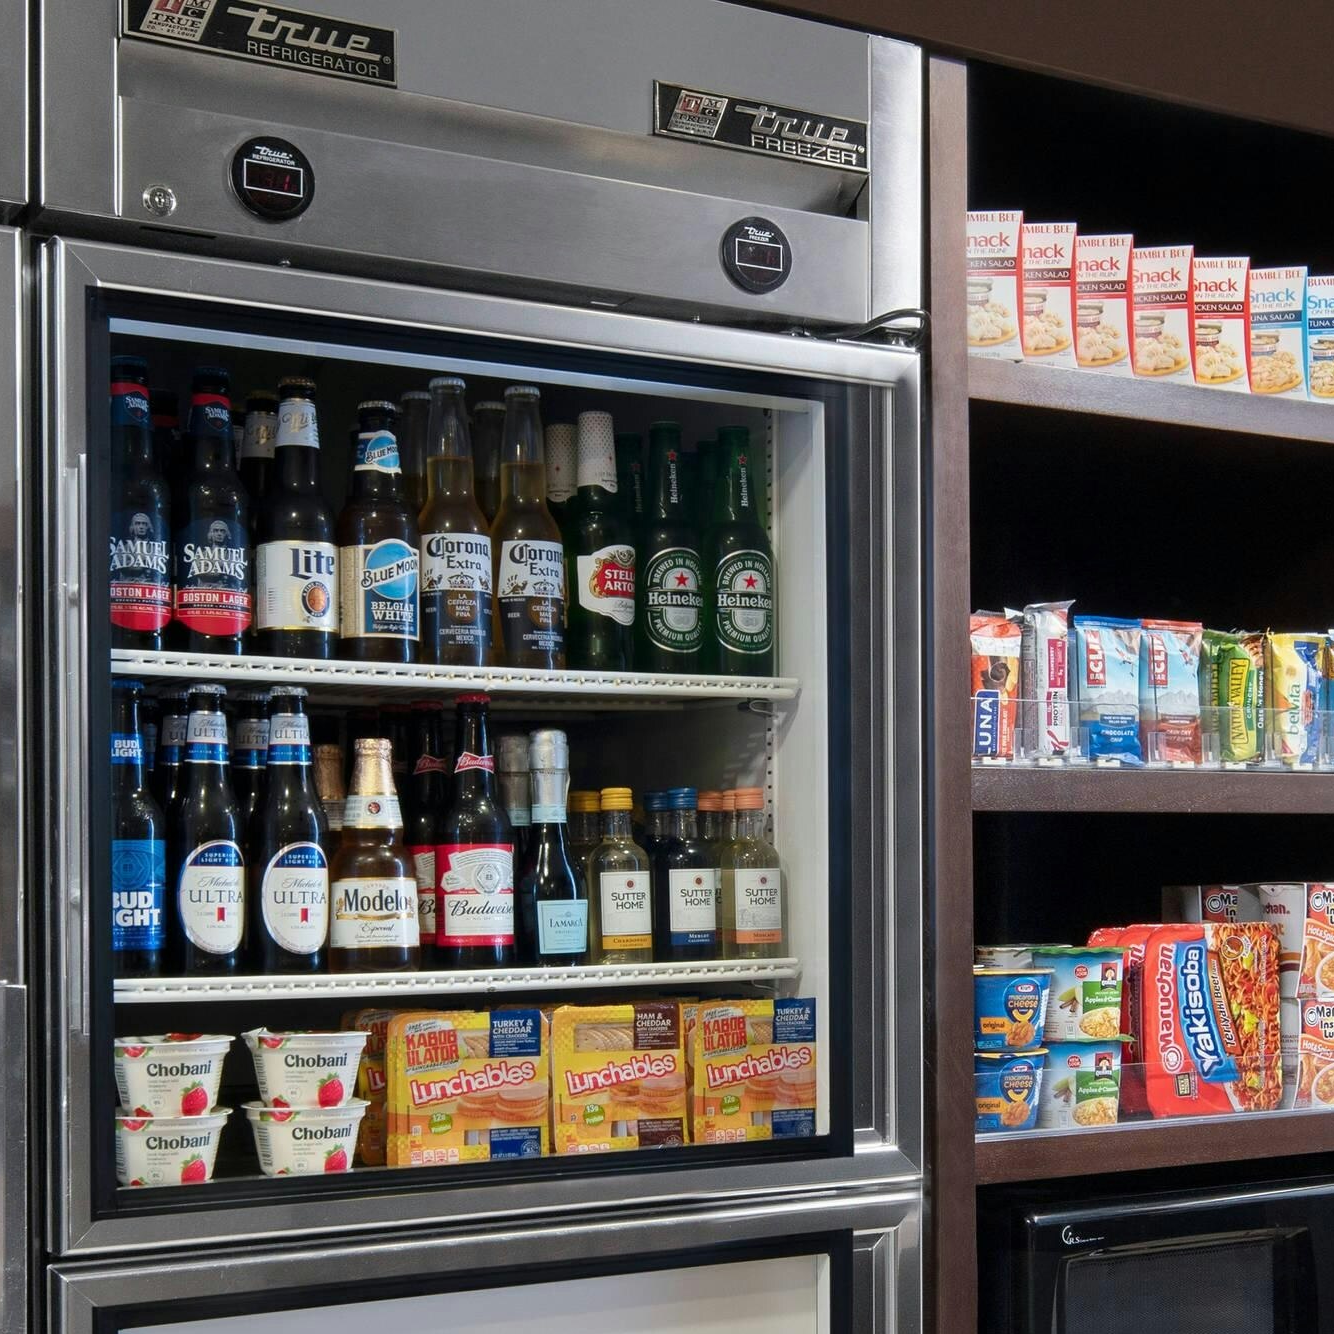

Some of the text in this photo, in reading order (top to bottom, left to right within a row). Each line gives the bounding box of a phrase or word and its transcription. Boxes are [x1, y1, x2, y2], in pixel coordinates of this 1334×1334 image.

[152, 12, 202, 28] TRUE
[248, 41, 379, 77] REFRIGERATOR
[751, 135, 857, 165] FREEZER
[988, 259, 1015, 267] SALAD
[740, 467, 748, 507] Heineken
[183, 543, 248, 566] SAMUEL
[289, 547, 335, 580] Lite
[187, 559, 244, 580] ADAMS
[371, 601, 414, 612] BELGIAN
[1089, 631, 1102, 672] CLIF
[1153, 634, 1164, 674] CLIF
[1230, 661, 1246, 702] VALLEY
[114, 740, 138, 749] BUD
[343, 888, 408, 913] Modelo
[611, 892, 646, 901] SUTTER
[680, 888, 712, 898] SUTTER
[685, 898, 711, 906] HOME
[449, 894, 514, 915] Budweise
[616, 901, 644, 910] HOME
[1198, 947, 1217, 1068] Yakisoba
[493, 1019, 524, 1028] TURKEY
[637, 1019, 671, 1027] CHEDDAR
[703, 1018, 745, 1034] KABOB
[1218, 1000, 1236, 1048] Teriyaki
[405, 1029, 457, 1050] KABOB
[704, 1031, 747, 1051] ULATOR
[284, 1053, 347, 1068] Chobani
[406, 1045, 460, 1067] ULATOR
[147, 1060, 211, 1077] Chobani
